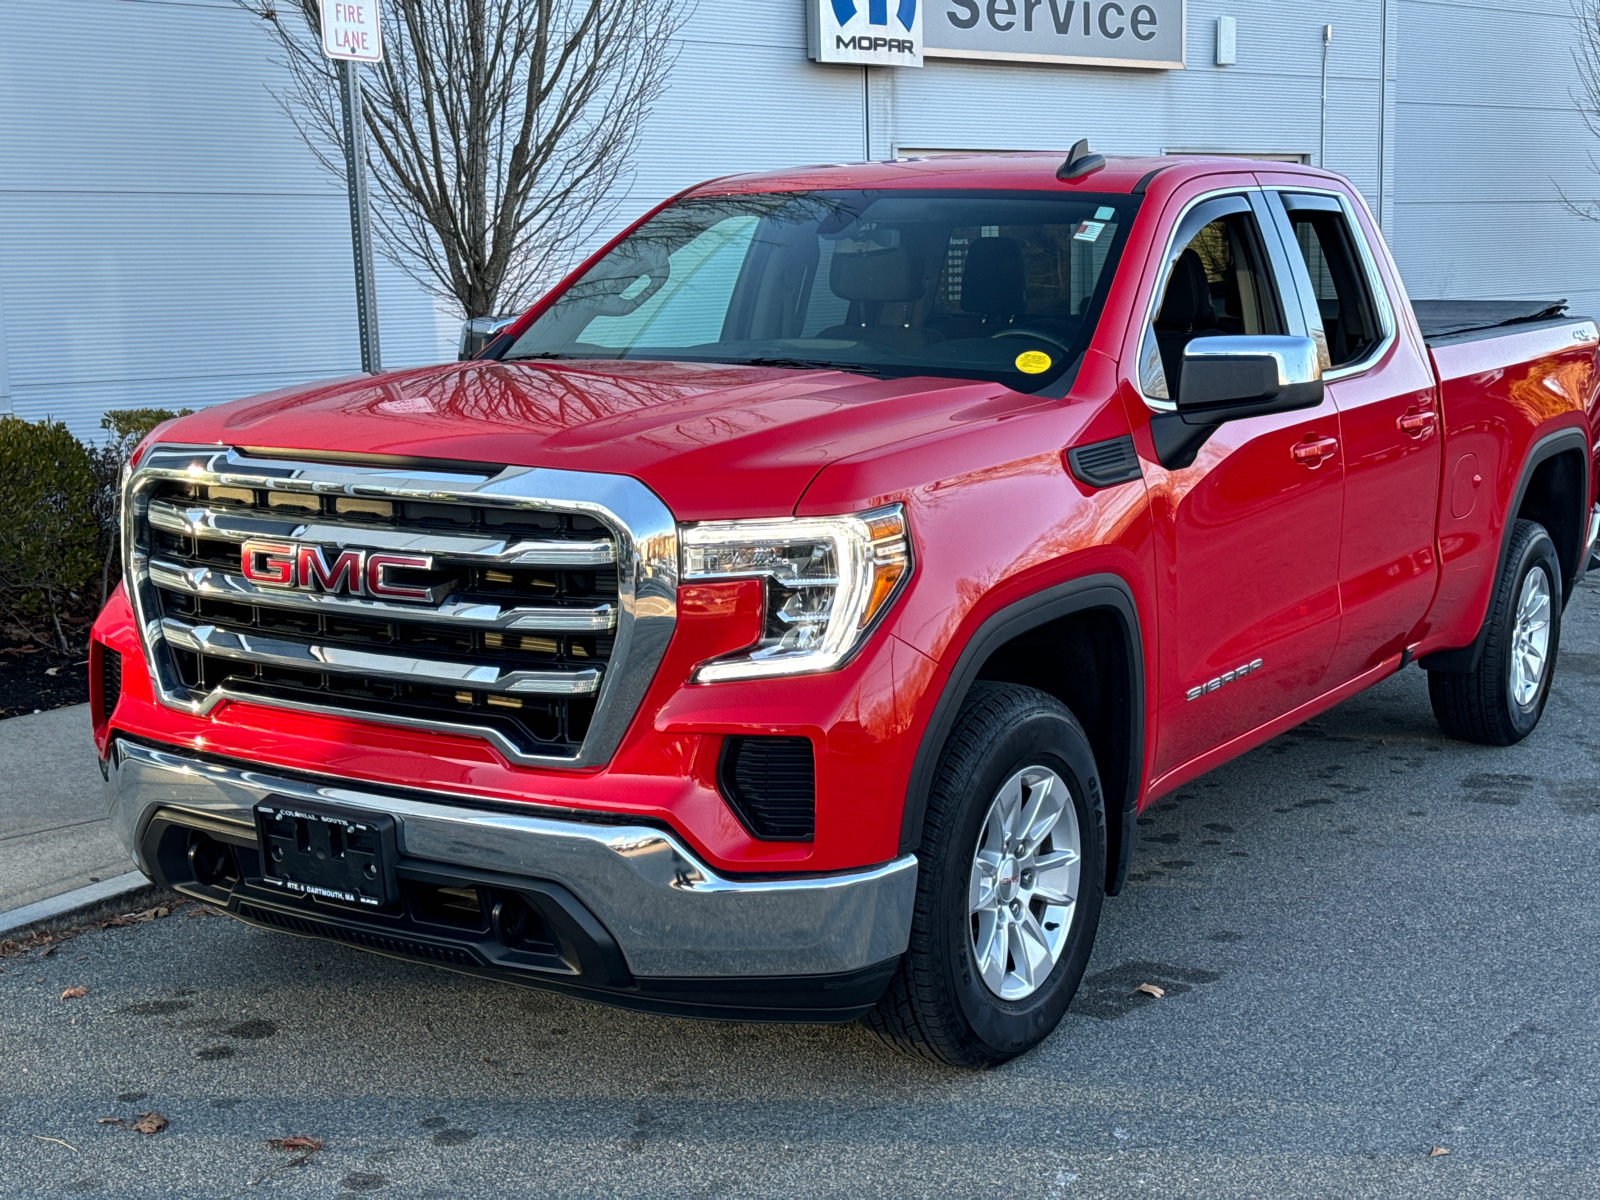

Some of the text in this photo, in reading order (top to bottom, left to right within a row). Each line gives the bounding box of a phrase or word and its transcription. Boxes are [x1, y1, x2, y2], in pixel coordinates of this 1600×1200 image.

[335, 3, 365, 24] FIRE
[946, 0, 1158, 41] Service
[335, 28, 369, 50] LANE
[835, 35, 915, 55] MOPAR
[242, 539, 433, 601] GMC
[1185, 658, 1263, 702] SIERRA
[321, 816, 348, 826] SOUTH
[345, 892, 355, 902] MA
